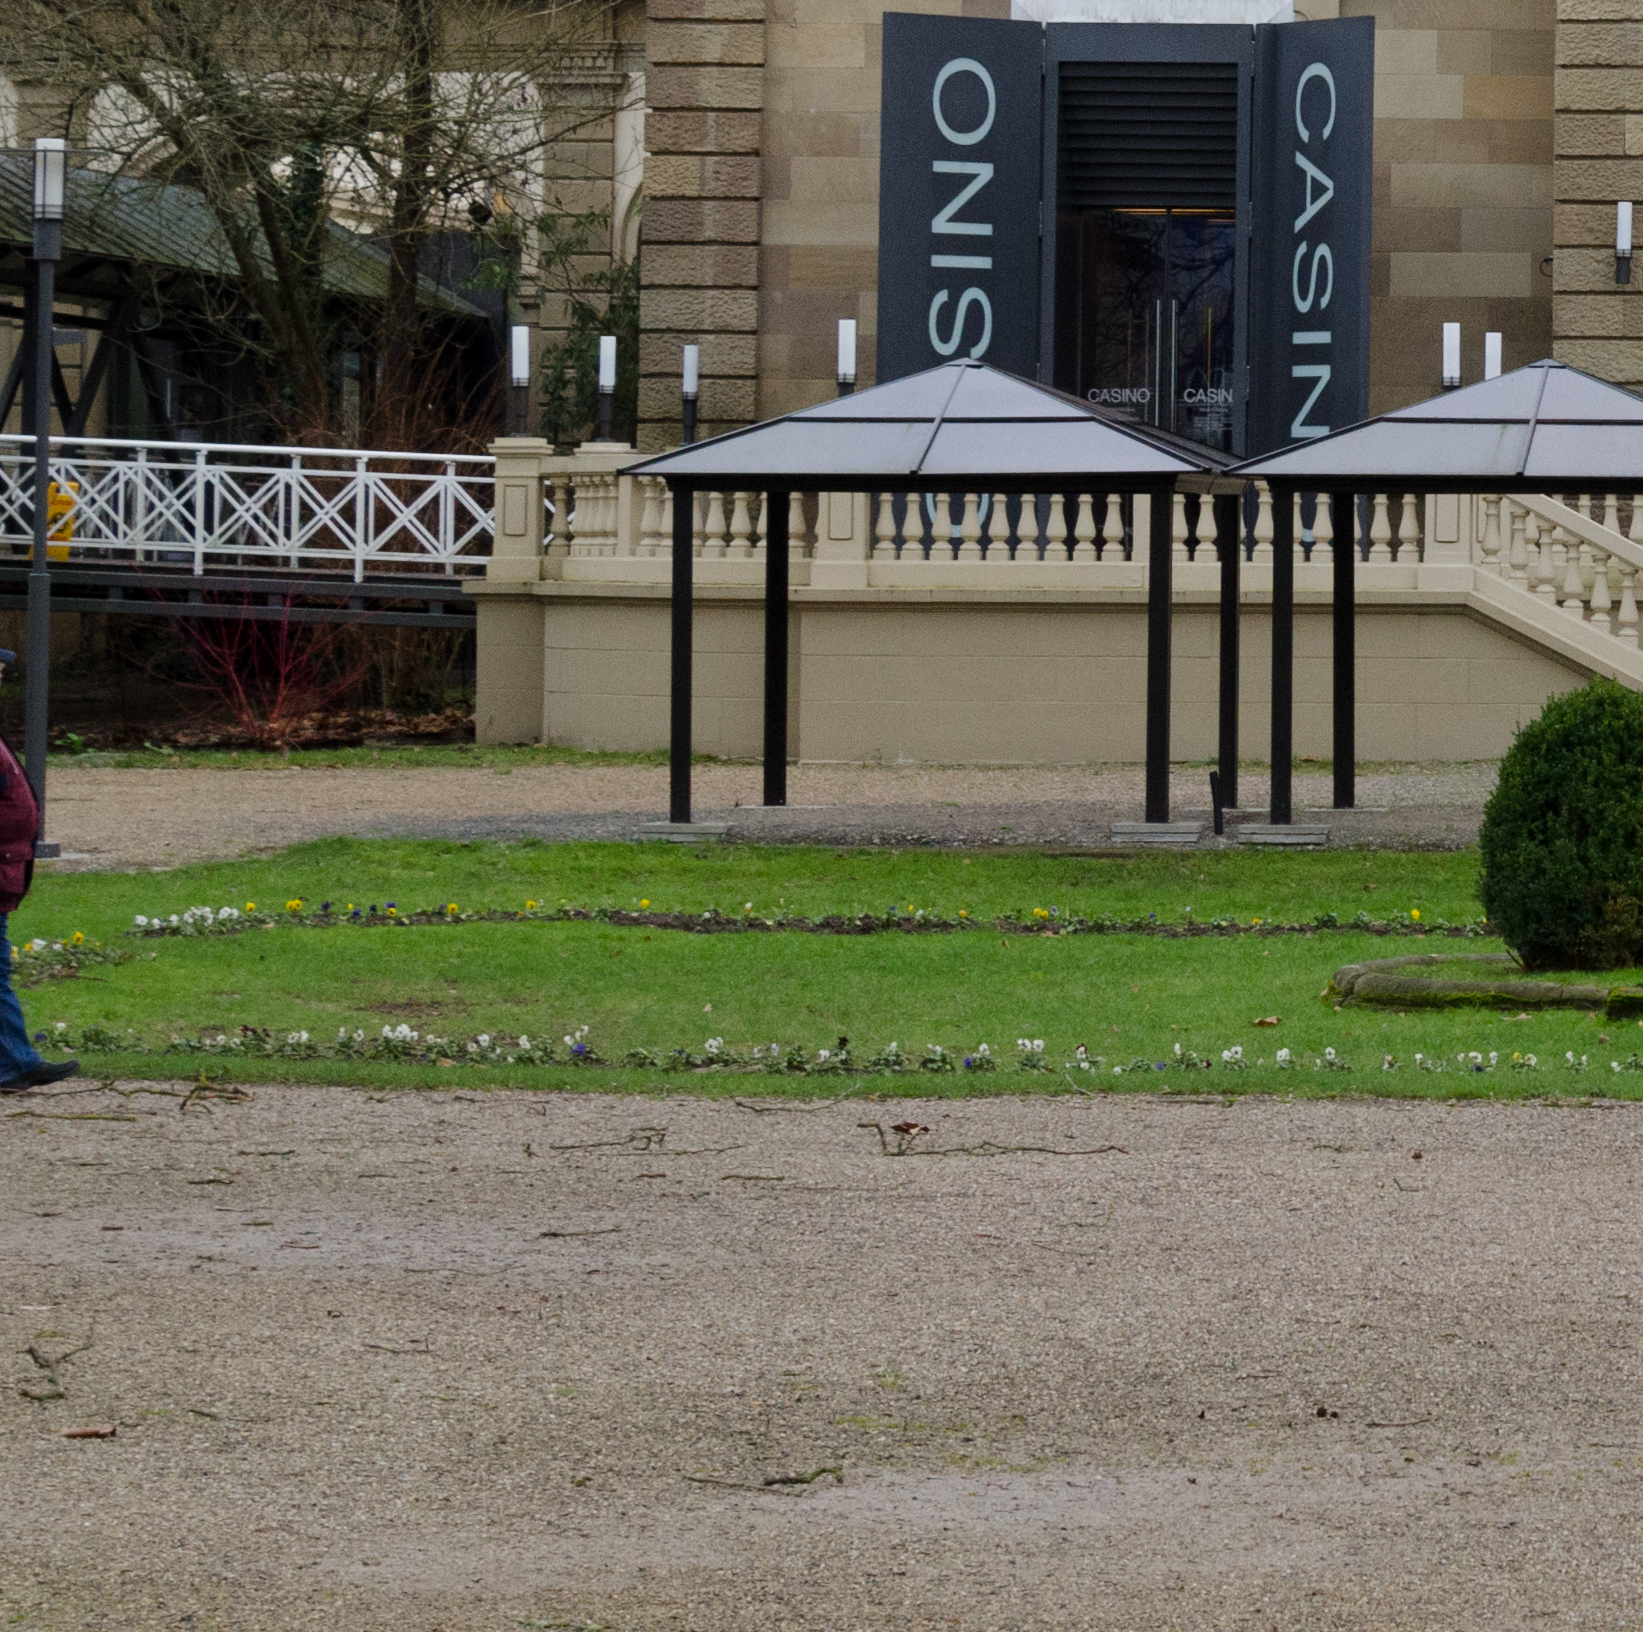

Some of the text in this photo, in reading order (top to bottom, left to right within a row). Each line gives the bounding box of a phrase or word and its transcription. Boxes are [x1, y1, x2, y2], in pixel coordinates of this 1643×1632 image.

[926, 56, 996, 539] SINO
[1290, 62, 1336, 440] CASIN
[1087, 388, 1151, 403] CASINO
[1183, 388, 1233, 403] CASIN
